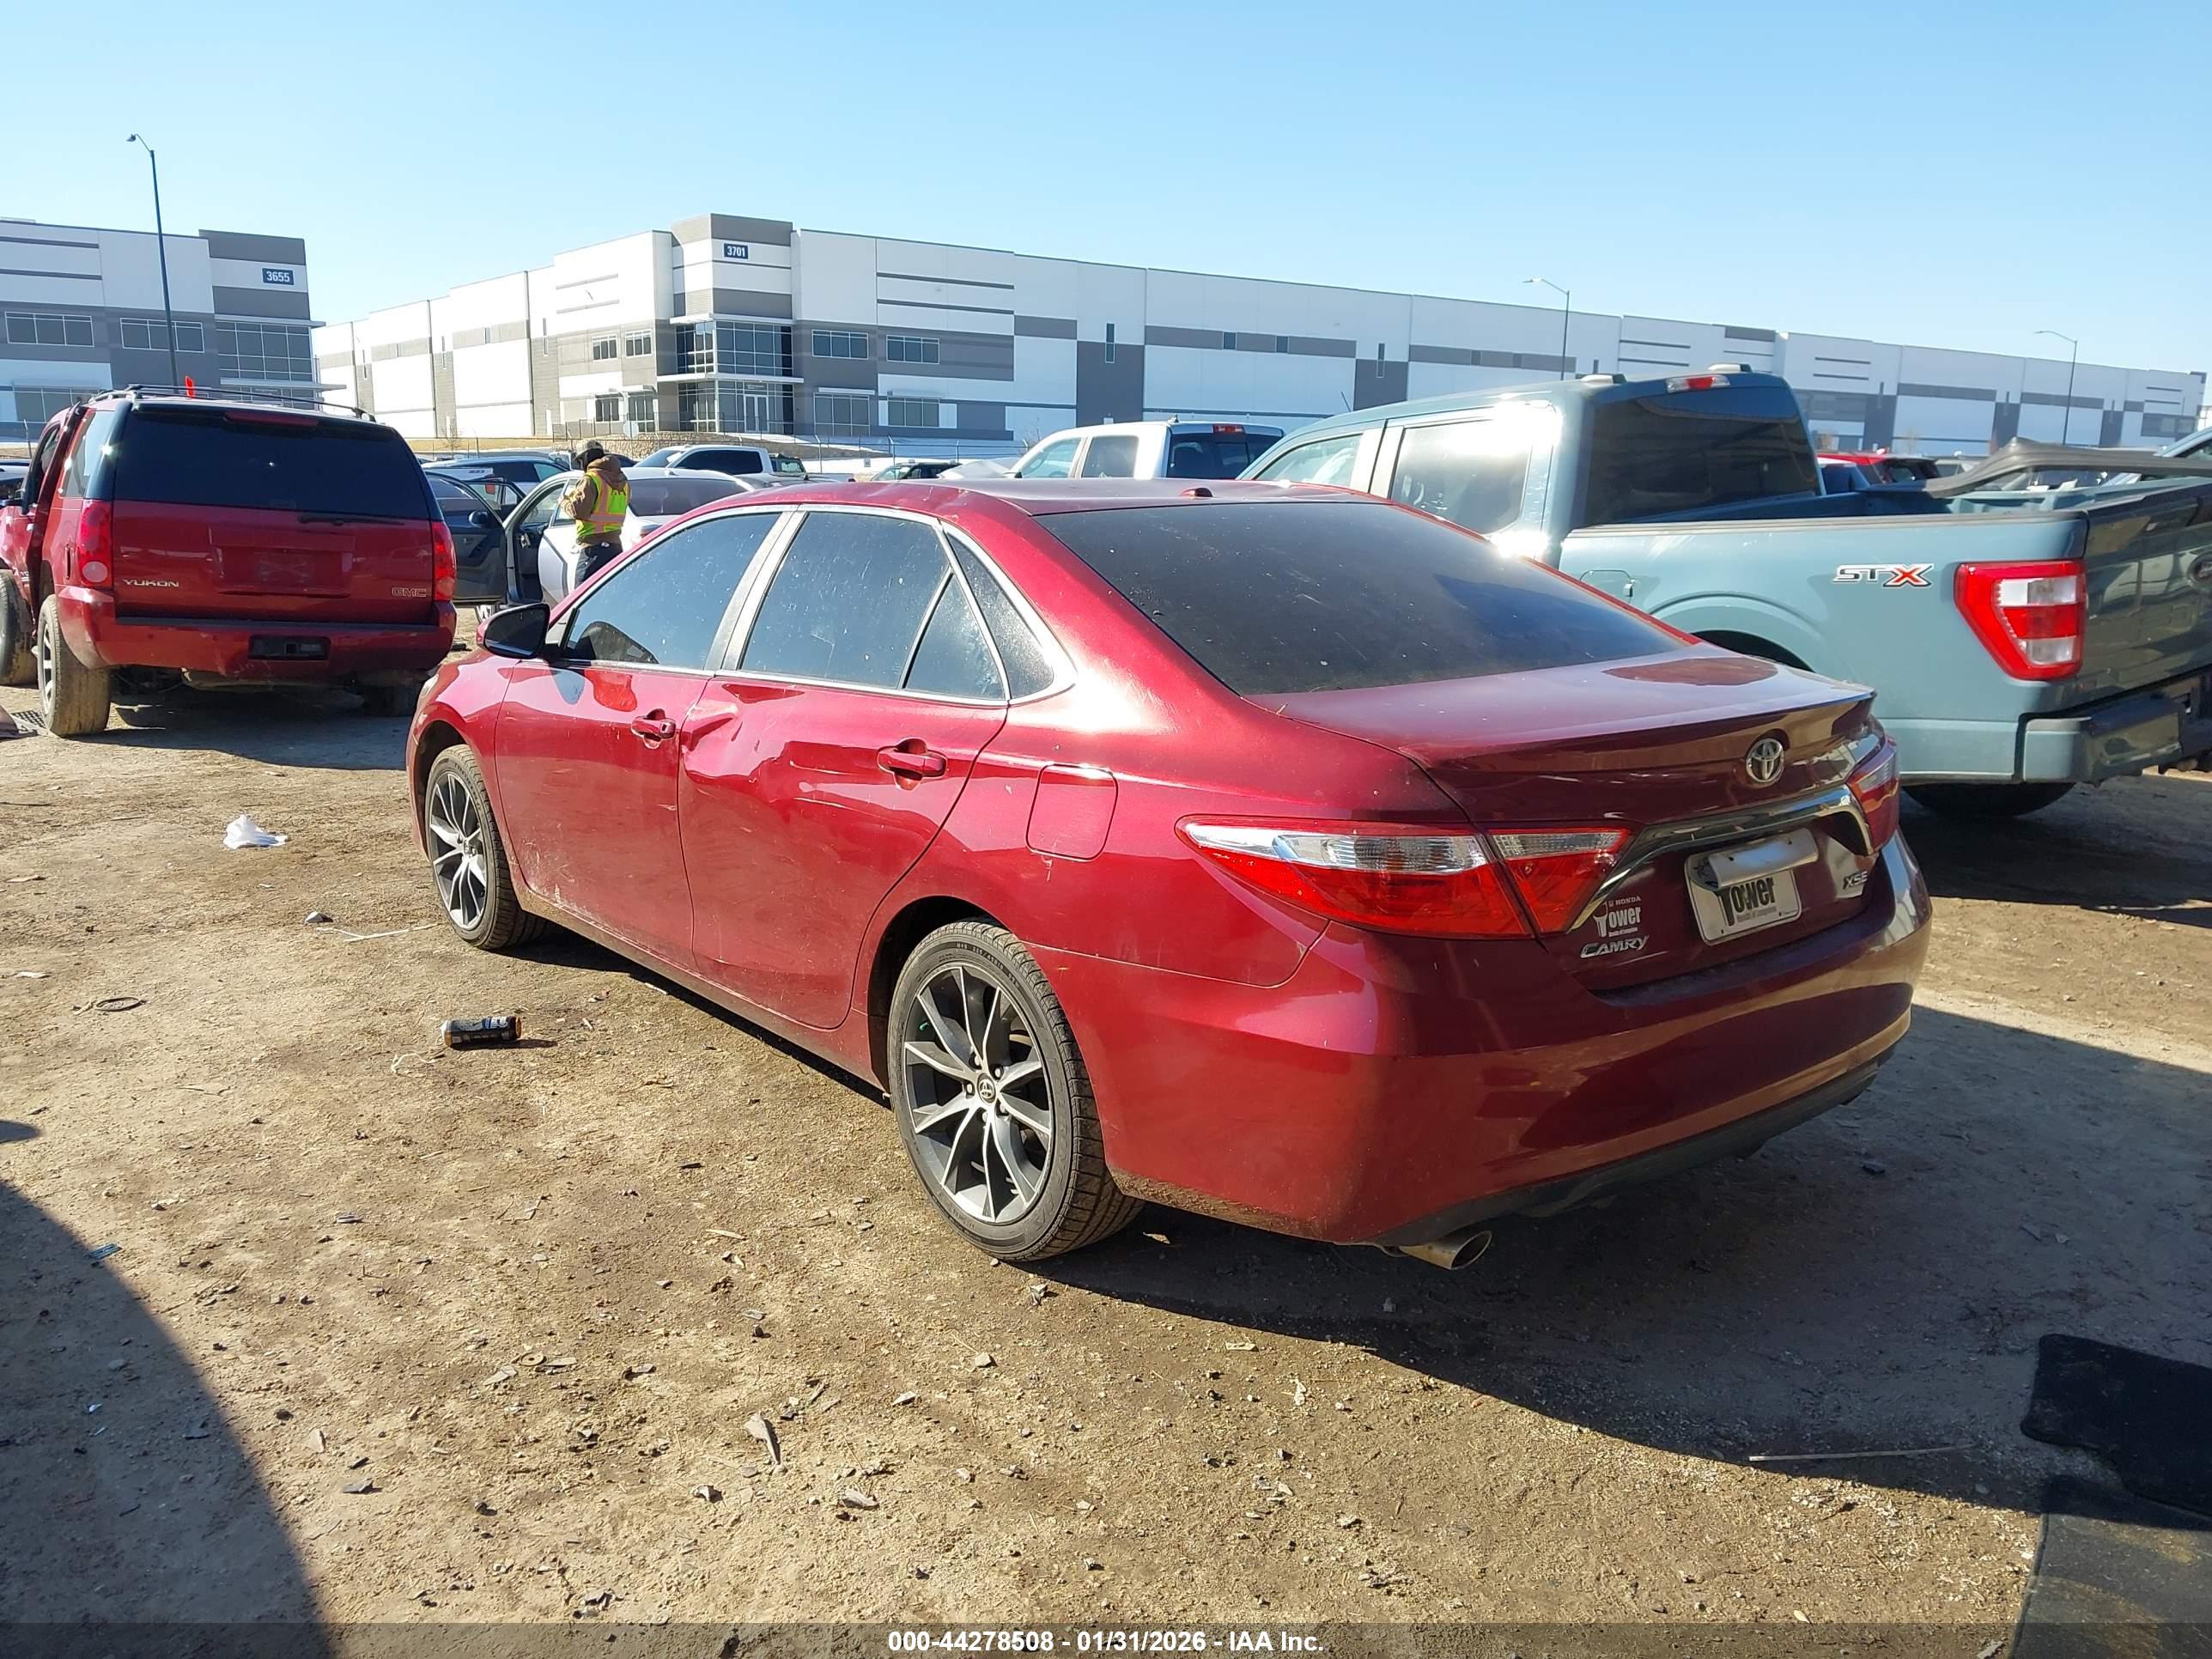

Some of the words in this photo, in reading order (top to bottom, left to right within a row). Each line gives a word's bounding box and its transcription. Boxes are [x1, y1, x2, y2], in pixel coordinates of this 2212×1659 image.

[726, 246, 746, 258] 3701
[265, 270, 290, 283] 3655
[1832, 563, 1935, 588] STX
[123, 579, 179, 587] YUKON
[391, 586, 427, 598] GMC
[1844, 870, 1869, 888] XSE
[1615, 896, 1642, 906] HONDA
[1580, 935, 1650, 958] CAMRY
